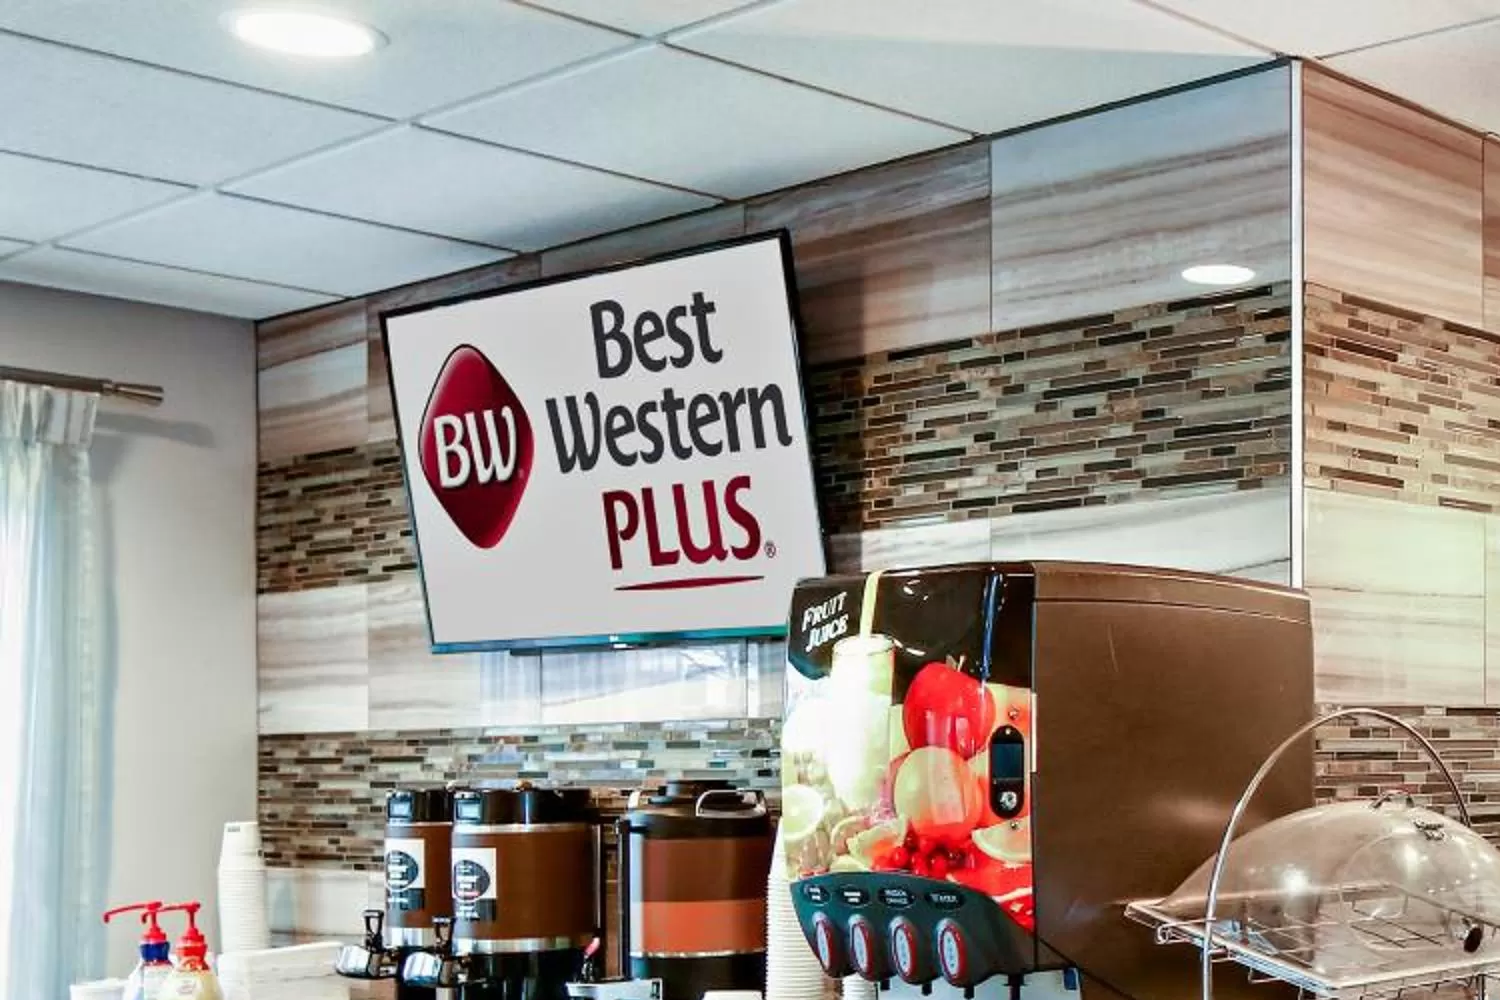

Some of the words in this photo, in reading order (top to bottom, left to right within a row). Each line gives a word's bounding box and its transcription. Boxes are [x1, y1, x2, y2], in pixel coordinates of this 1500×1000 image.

[590, 291, 724, 379] Best
[432, 405, 517, 489] BW
[545, 382, 793, 475] Western
[801, 591, 848, 633] FRUIT
[805, 613, 849, 653] JUICE
